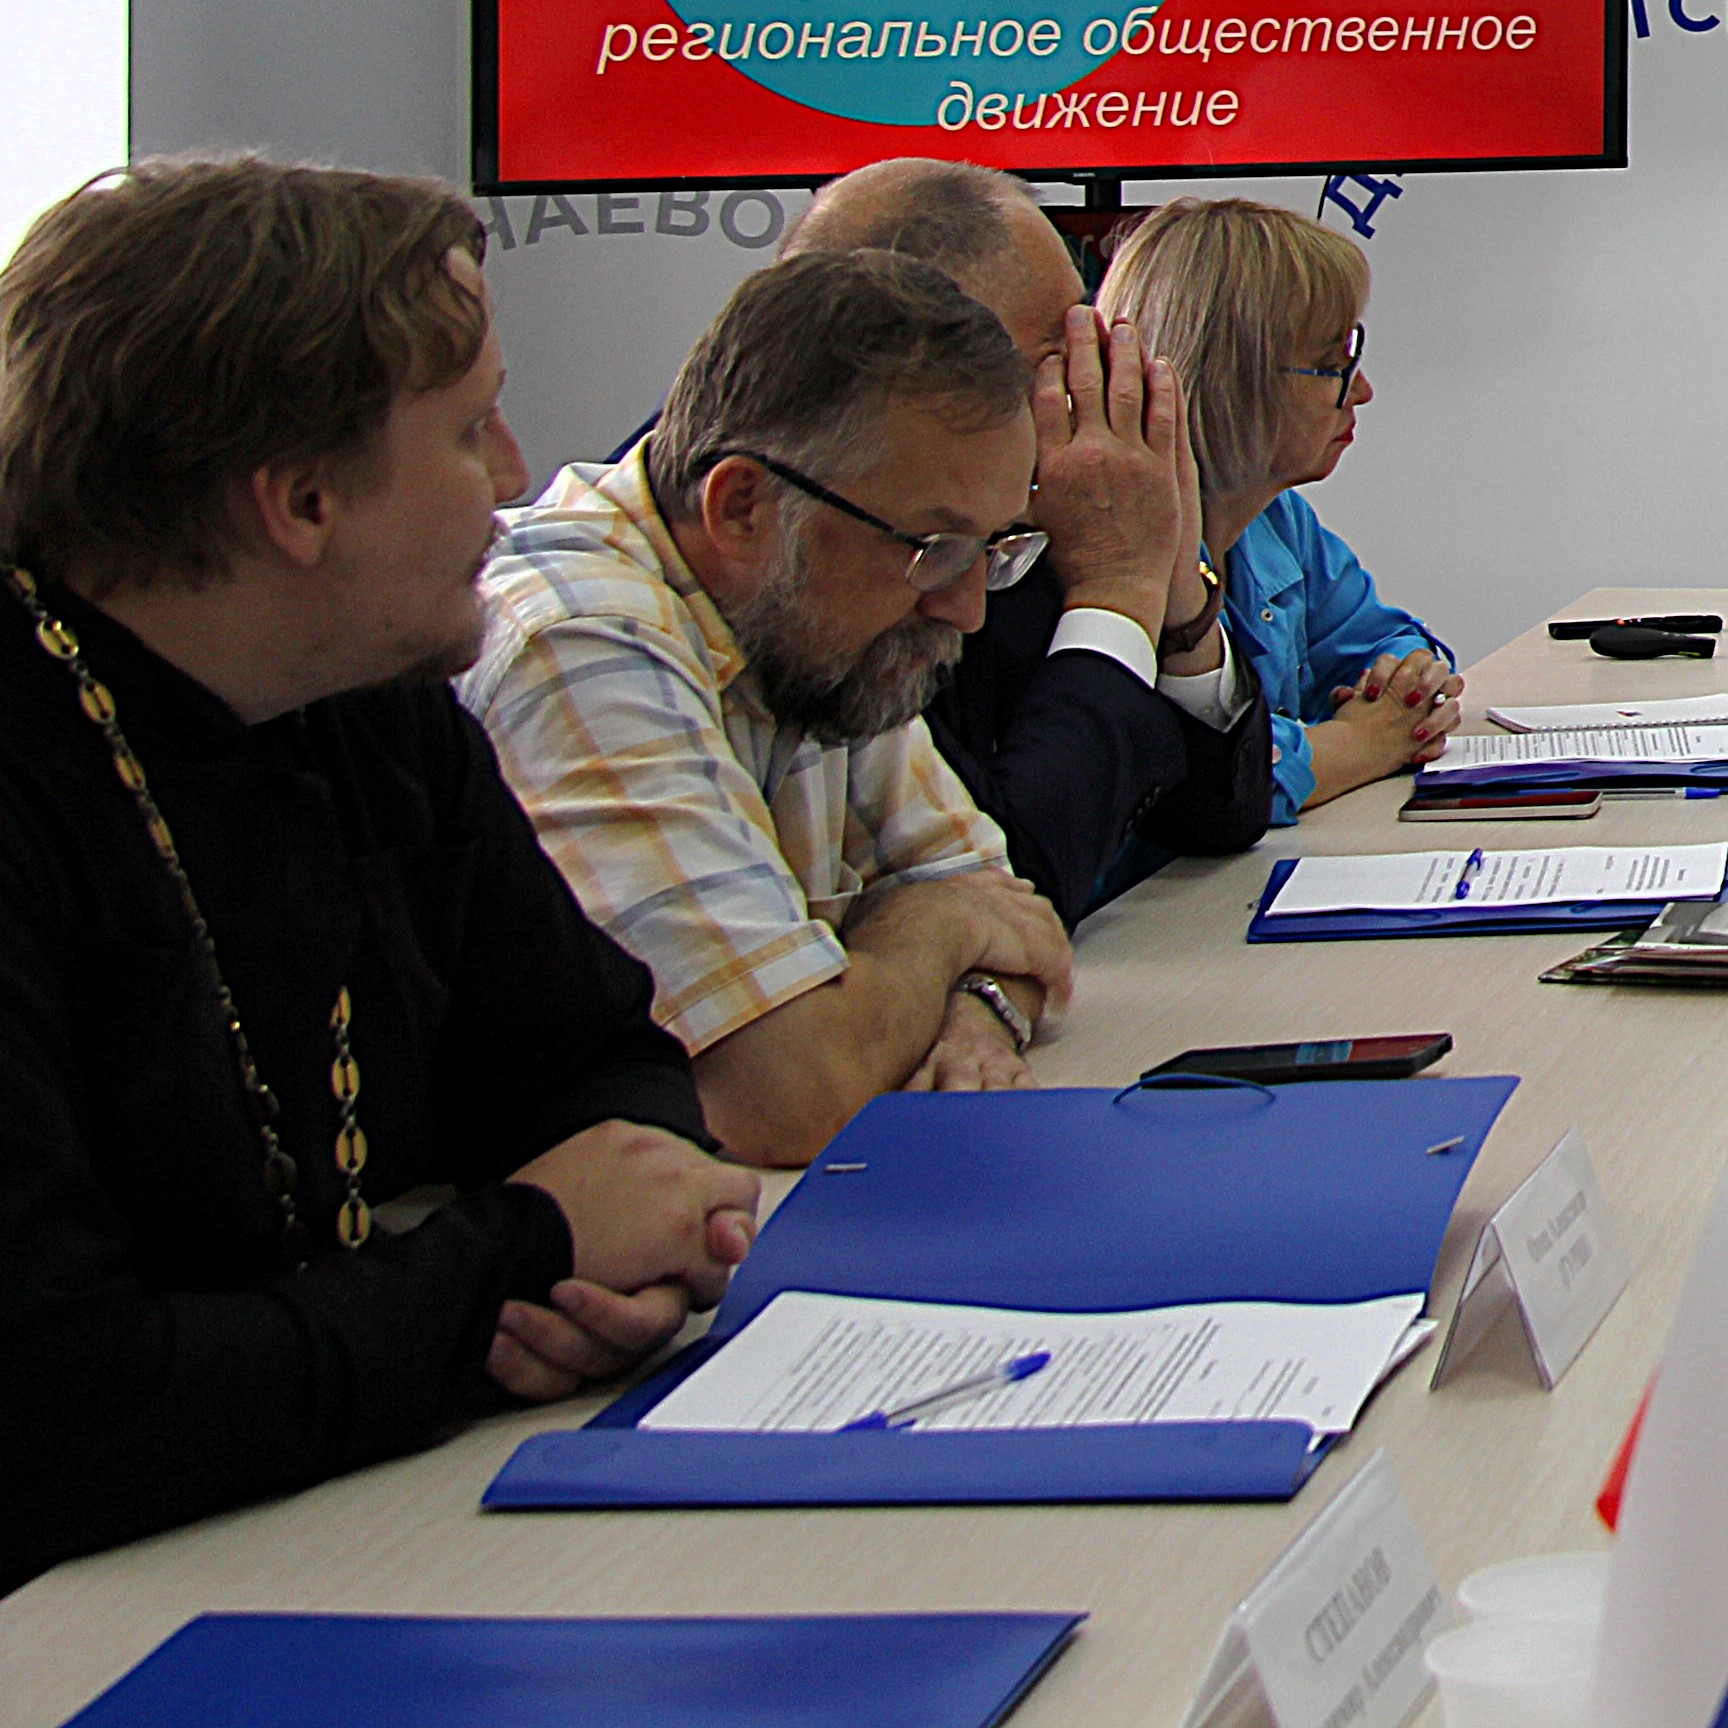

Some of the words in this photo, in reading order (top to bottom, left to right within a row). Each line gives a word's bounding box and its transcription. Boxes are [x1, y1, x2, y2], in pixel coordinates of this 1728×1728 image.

[597, 17, 1062, 75] региональное
[1083, 5, 1537, 63] общественное
[936, 80, 1239, 131] движение
[490, 188, 787, 251] АЕВО
